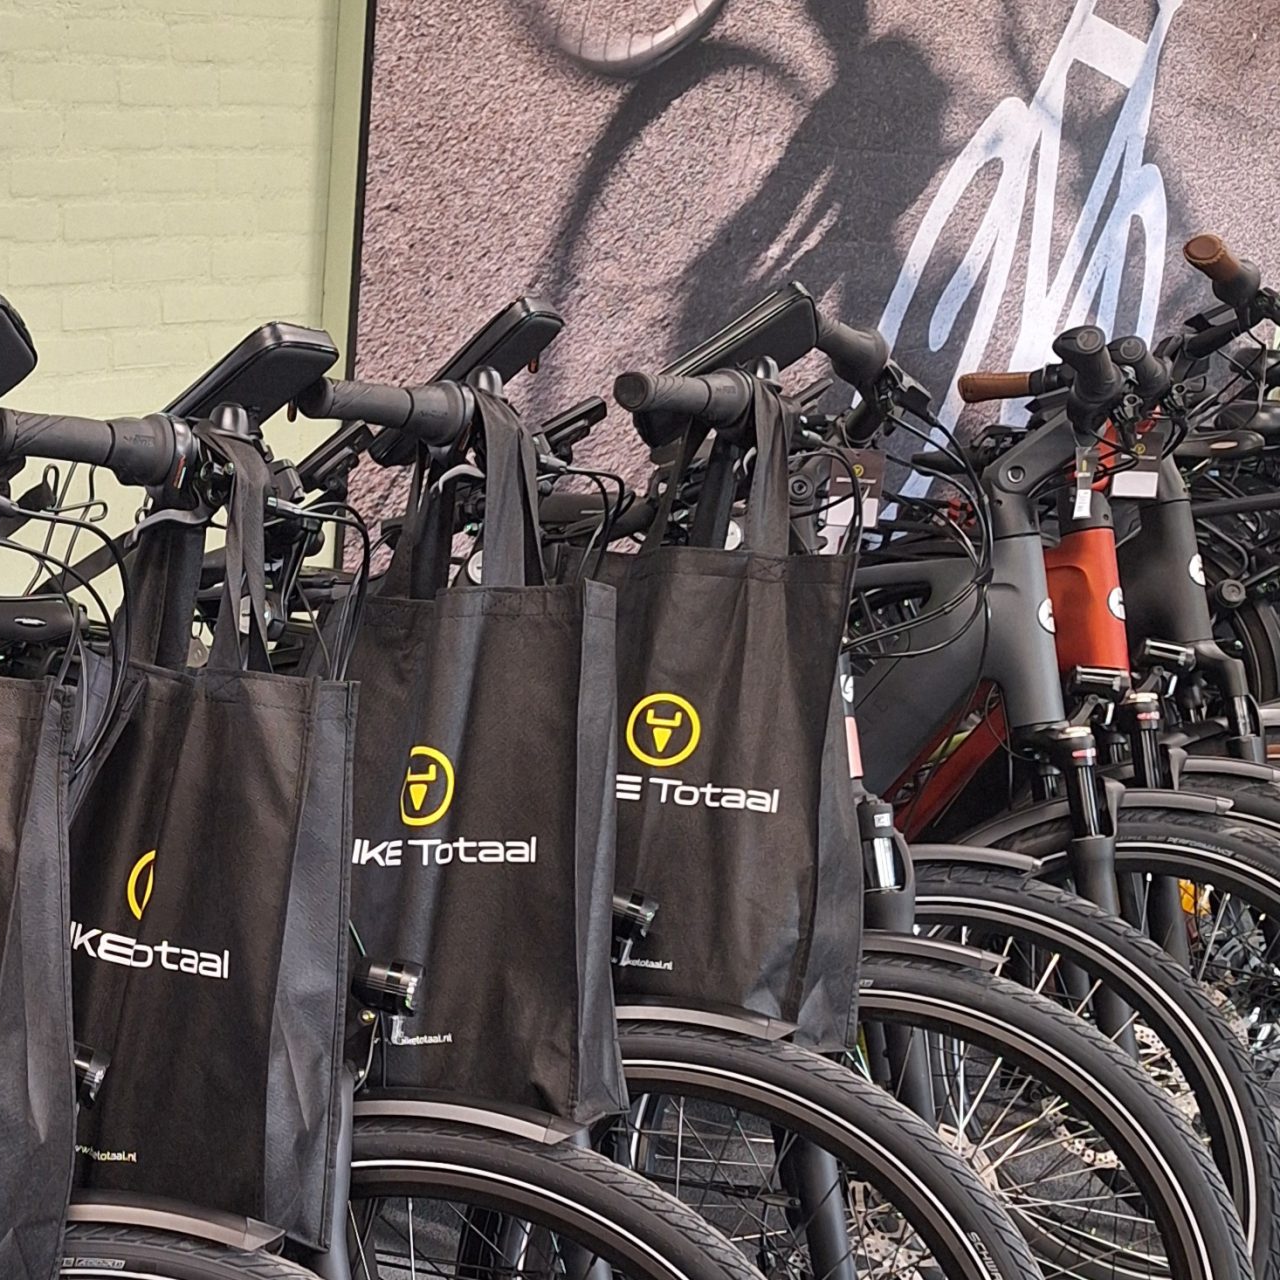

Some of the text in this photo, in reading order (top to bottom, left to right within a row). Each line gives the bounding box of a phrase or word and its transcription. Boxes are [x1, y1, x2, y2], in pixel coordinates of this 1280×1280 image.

[649, 777, 780, 814] Totaal
[352, 836, 537, 867] IKE Totaal
[70, 920, 230, 979] IKE otaal
